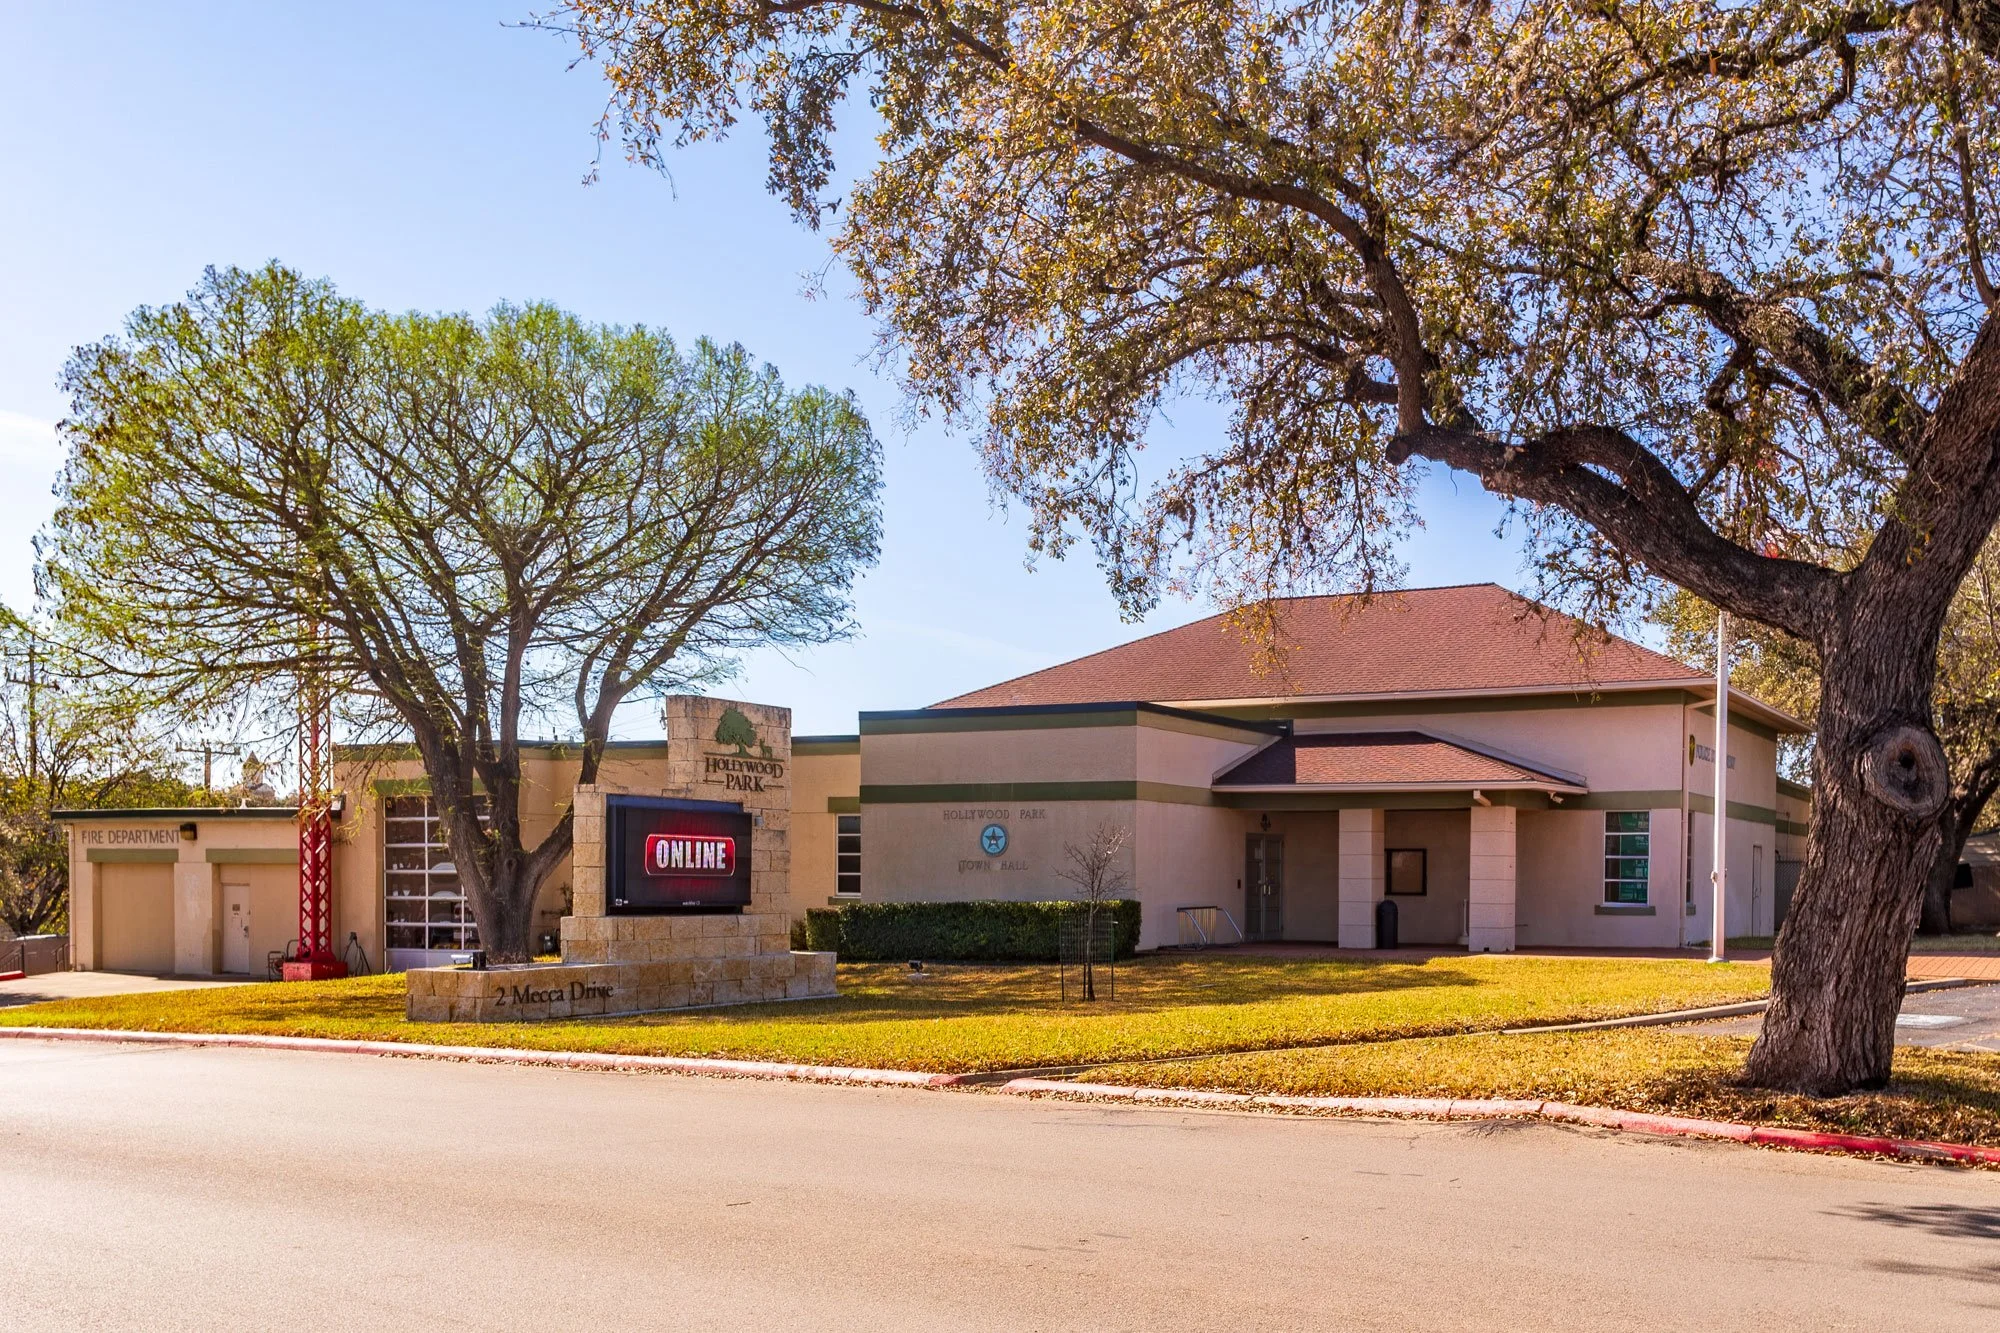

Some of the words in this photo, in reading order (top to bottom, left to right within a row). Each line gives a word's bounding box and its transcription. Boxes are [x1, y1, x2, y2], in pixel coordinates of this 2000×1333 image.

[705, 757, 784, 779] HOLLYWOOD
[725, 773, 765, 792] PARK
[943, 809, 1010, 820] HOLLYWOOD
[1020, 808, 1046, 819] PARK
[81, 830, 104, 844] FIRE
[108, 829, 180, 844] DEPARTMENT
[656, 839, 726, 869] ONLINE
[959, 860, 991, 872] TOWN
[1001, 860, 1029, 871] HALL
[494, 986, 506, 1006] 2
[512, 984, 565, 1004] Mecca
[570, 981, 614, 1001] Drive
